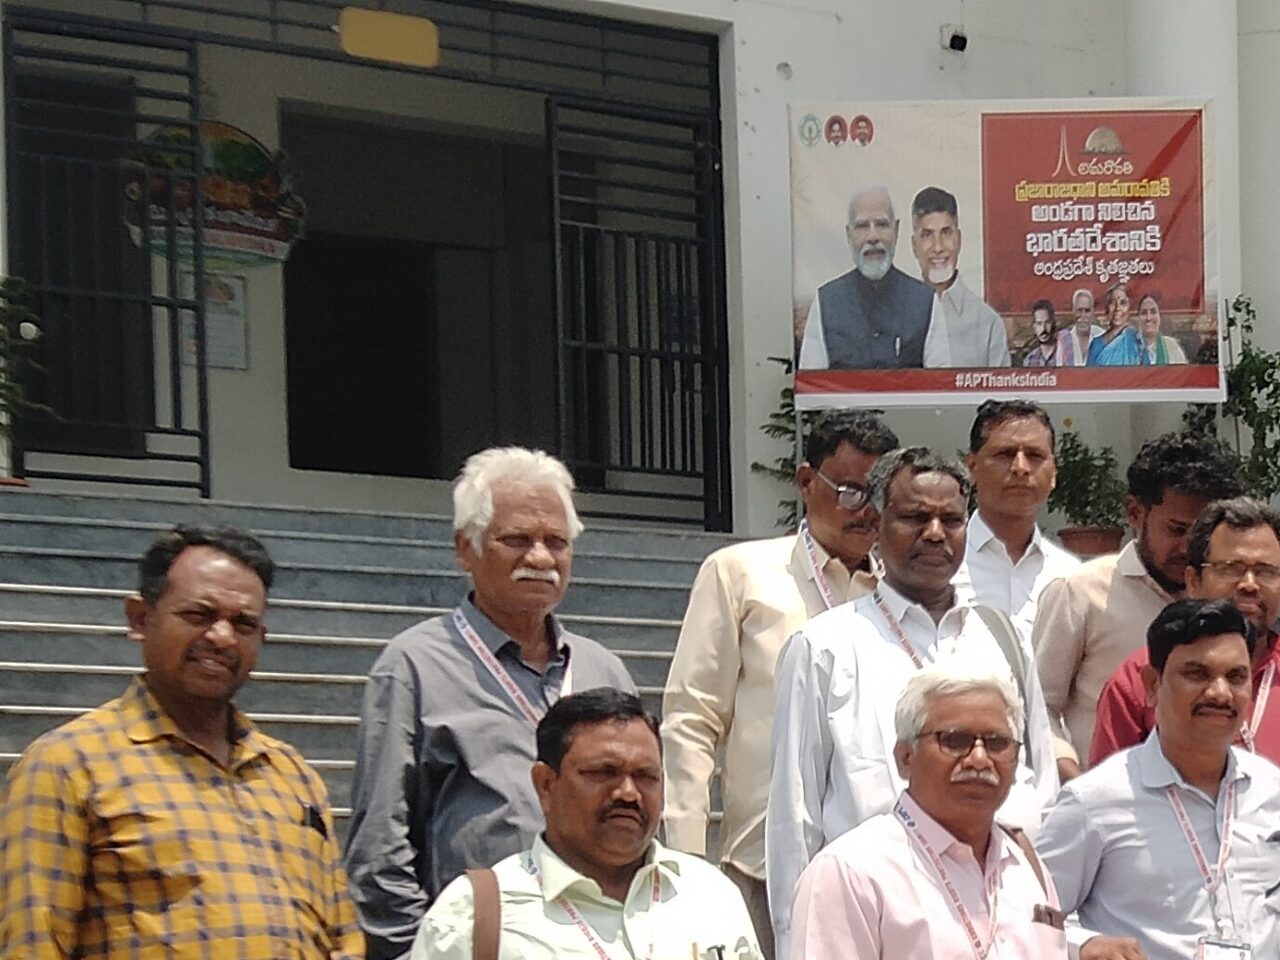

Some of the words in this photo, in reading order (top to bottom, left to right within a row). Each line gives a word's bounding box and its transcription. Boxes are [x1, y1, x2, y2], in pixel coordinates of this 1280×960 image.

[1031, 201, 1095, 222] అండగా
[1098, 200, 1156, 222] నిలిచిన
[1025, 222, 1162, 258] భారతదేశానికి
[955, 372, 1057, 388] #APThanksIndia
